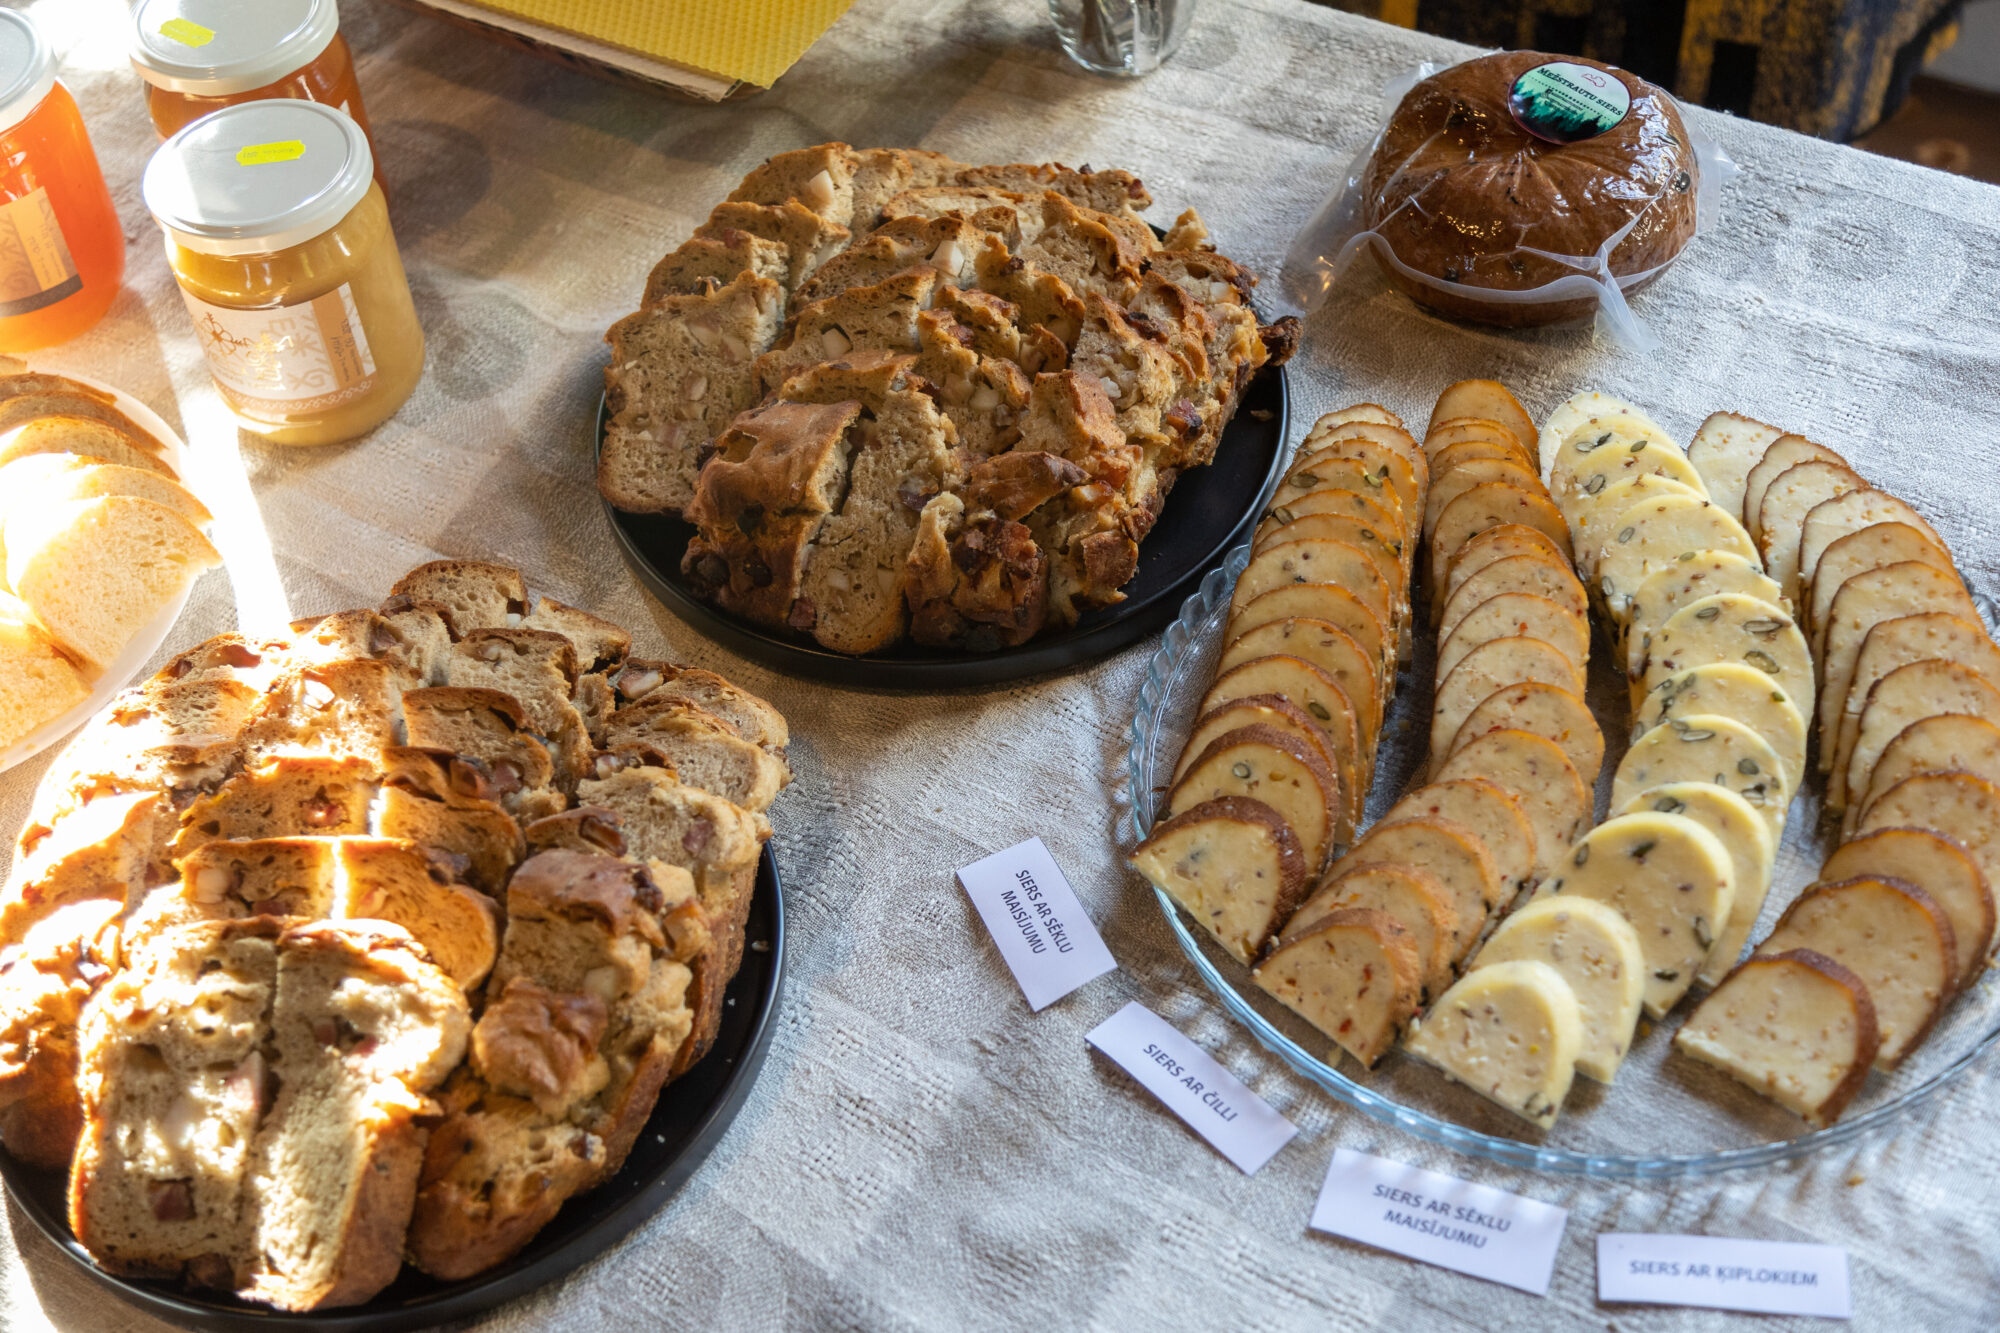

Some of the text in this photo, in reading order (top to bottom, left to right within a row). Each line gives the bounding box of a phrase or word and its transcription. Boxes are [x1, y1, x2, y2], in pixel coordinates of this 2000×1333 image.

[1537, 67, 1596, 101] MEŽSTRAUTU
[1596, 98, 1623, 116] SIERS
[1000, 890, 1047, 954] MAISĪJUMU
[1015, 869, 1074, 953] SIERS AR SĒKLU
[1143, 1044, 1238, 1122] SIERS AR ČILLI
[1372, 1183, 1511, 1233] SIERS AR SĒKLU
[1383, 1209, 1488, 1249] MAISĪJUMU
[1629, 1260, 1681, 1276] SIERS
[1686, 1265, 1711, 1278] AR
